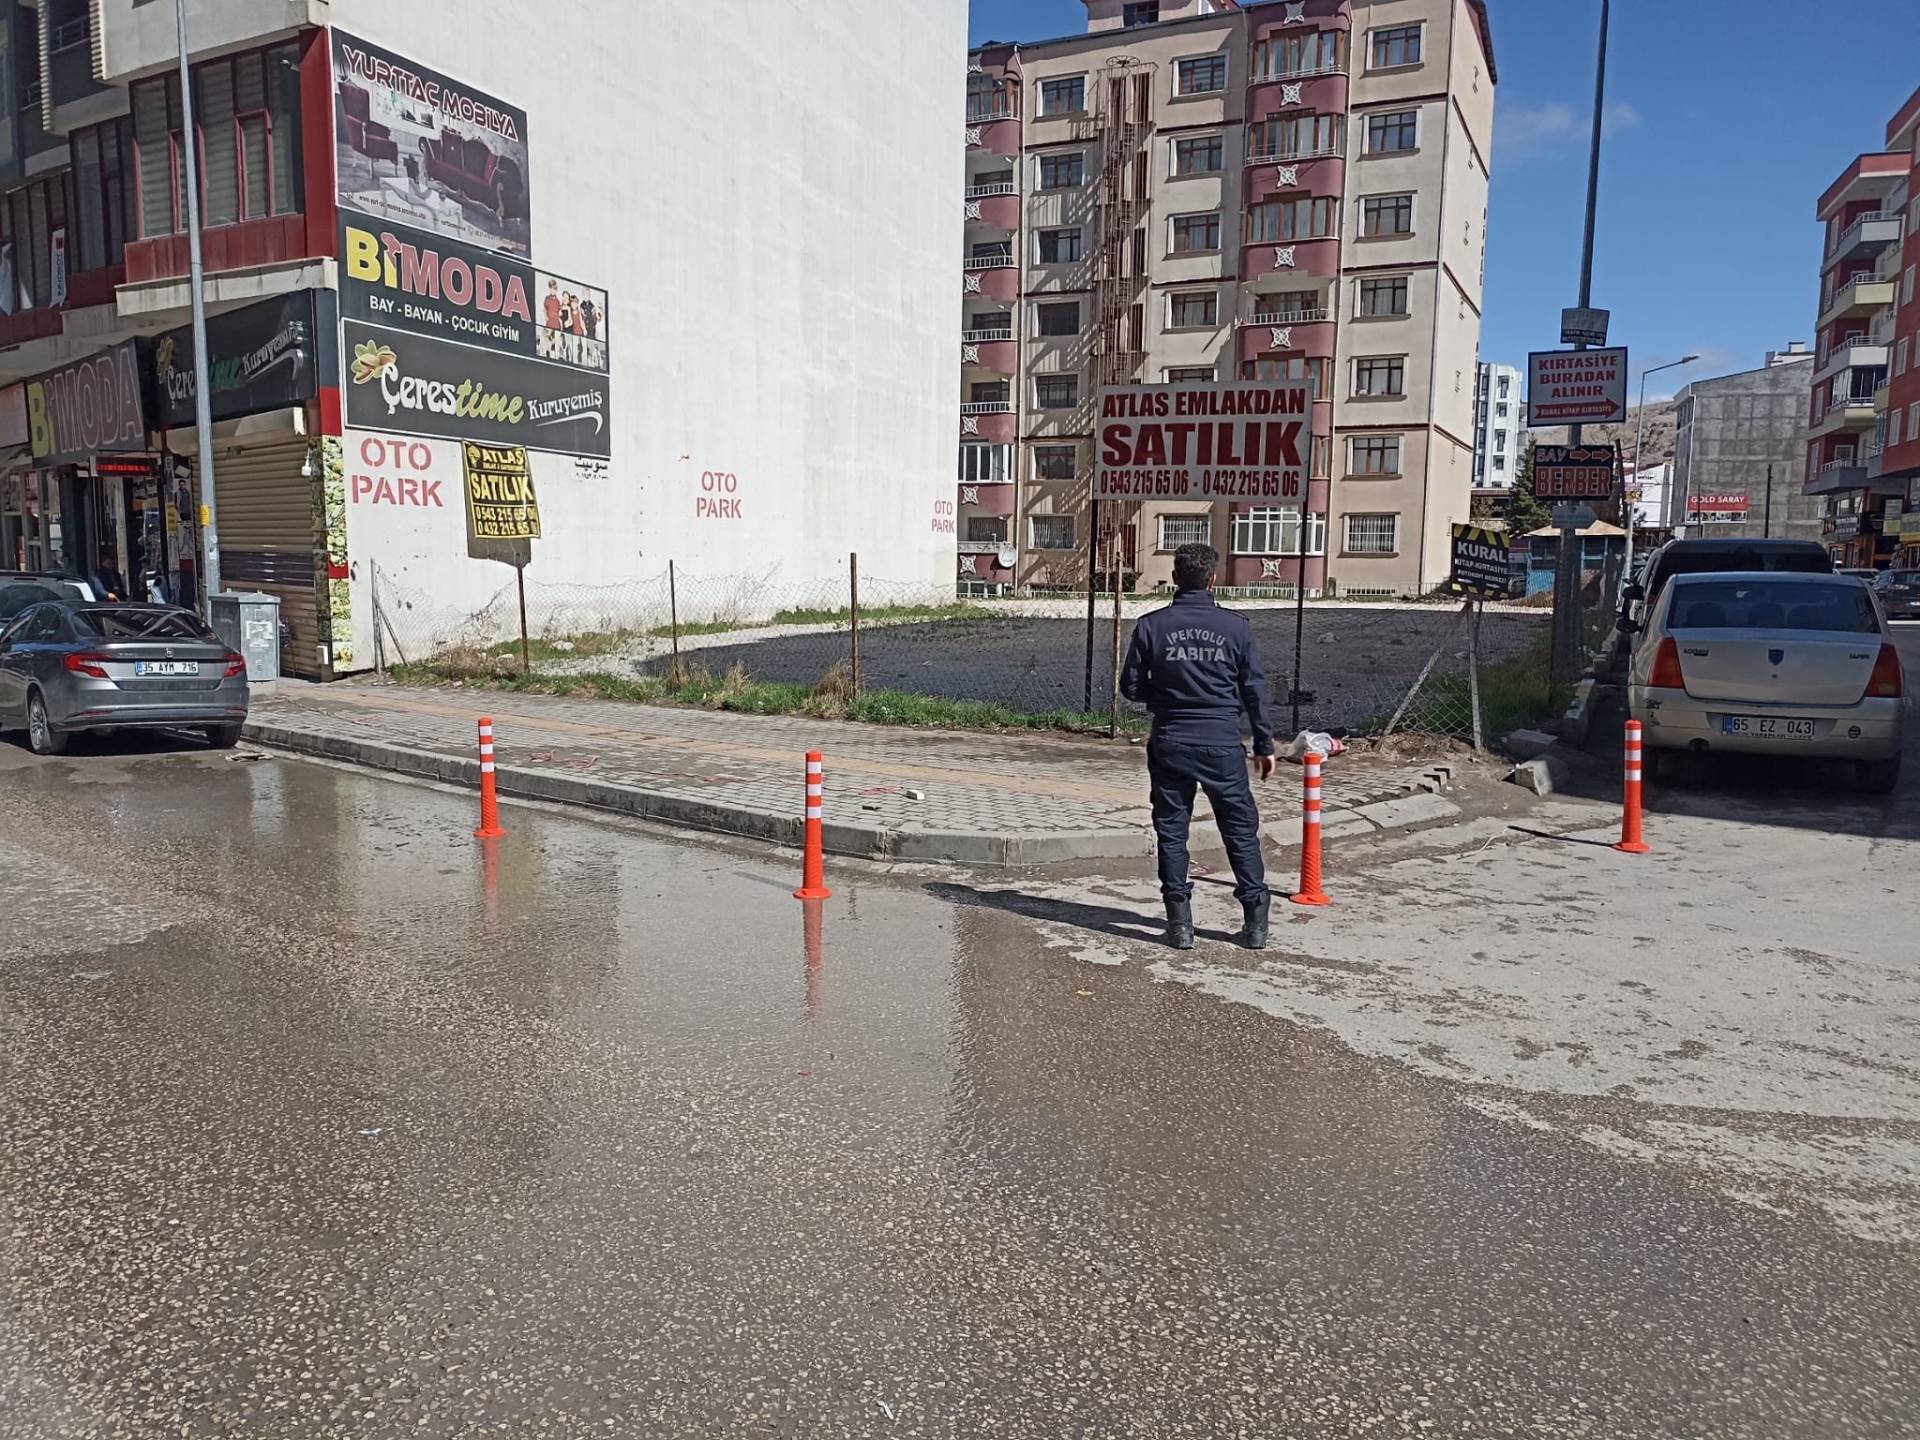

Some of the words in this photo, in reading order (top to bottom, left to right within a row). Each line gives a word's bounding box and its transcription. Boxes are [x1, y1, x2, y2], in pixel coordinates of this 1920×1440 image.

[369, 295, 394, 314] BAY
[404, 306, 442, 325] BAYAN
[451, 315, 489, 336] ÇOCUK
[492, 320, 520, 343] GİYİM
[1538, 352, 1617, 371] KIRTASİYE
[1540, 370, 1616, 385] BURADAN
[1551, 385, 1604, 399] ALINIR
[527, 389, 603, 420] Kuruyemiş
[1102, 392, 1169, 418] ATLAS
[1175, 388, 1306, 416] EMLAKDAN
[360, 437, 433, 471] OTO
[1102, 421, 1304, 467] SATILIK
[483, 448, 524, 465] ATLAS
[351, 475, 444, 508] PARK
[470, 473, 534, 501] SATILIK
[701, 471, 737, 493] OTO
[1101, 470, 1107, 494] 0
[1110, 470, 1131, 494] 543
[1134, 470, 1153, 494] 215
[1155, 470, 1170, 494] 65
[1173, 470, 1189, 495] 06
[1203, 470, 1210, 495] 0
[1213, 470, 1236, 495] 432
[1239, 471, 1260, 496] 215
[1262, 471, 1279, 496] 65
[1283, 471, 1299, 497] 06
[475, 506, 482, 520] 0
[482, 507, 497, 521] 543
[498, 507, 513, 521] 215
[696, 497, 742, 519] PARK
[934, 500, 953, 516] OTO
[478, 521, 484, 535] 0
[484, 522, 500, 535] 432
[500, 522, 516, 535] 215
[517, 522, 530, 535] 65
[931, 518, 955, 534] PARK
[1457, 541, 1507, 564] KURAL
[1165, 647, 1225, 662] ZABITA
[143, 662, 154, 672] 35
[158, 662, 175, 672] AYM
[181, 662, 197, 672] 716
[1733, 718, 1749, 732] 65
[1760, 719, 1776, 733] EZ
[1786, 720, 1812, 735] 043
